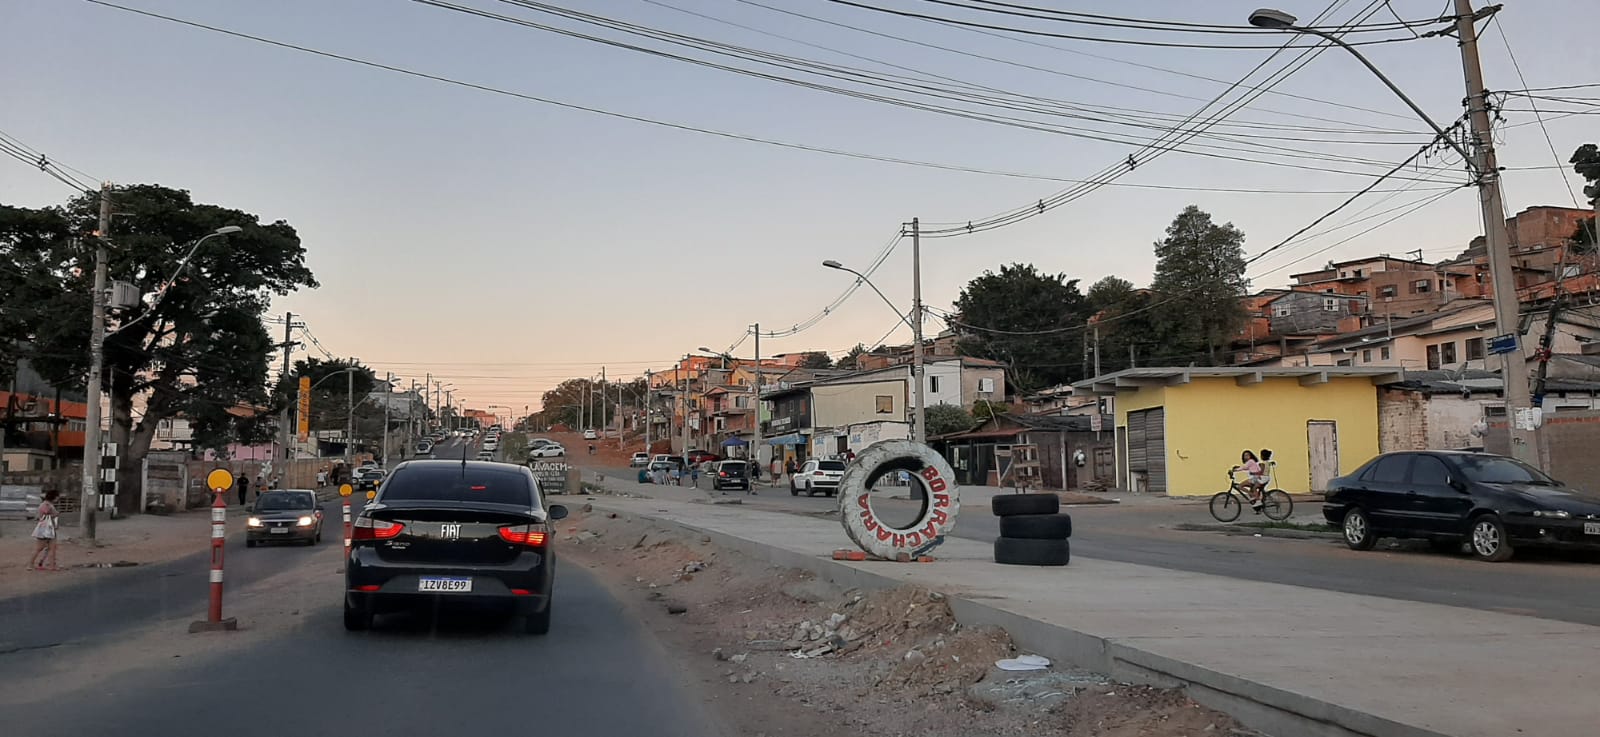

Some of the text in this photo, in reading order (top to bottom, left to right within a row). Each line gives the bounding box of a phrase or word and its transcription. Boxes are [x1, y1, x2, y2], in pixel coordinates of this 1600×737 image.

[858, 465, 951, 548] BORRACHARIA
[441, 524, 462, 540] FIAT
[423, 580, 466, 590] IZV8E99
